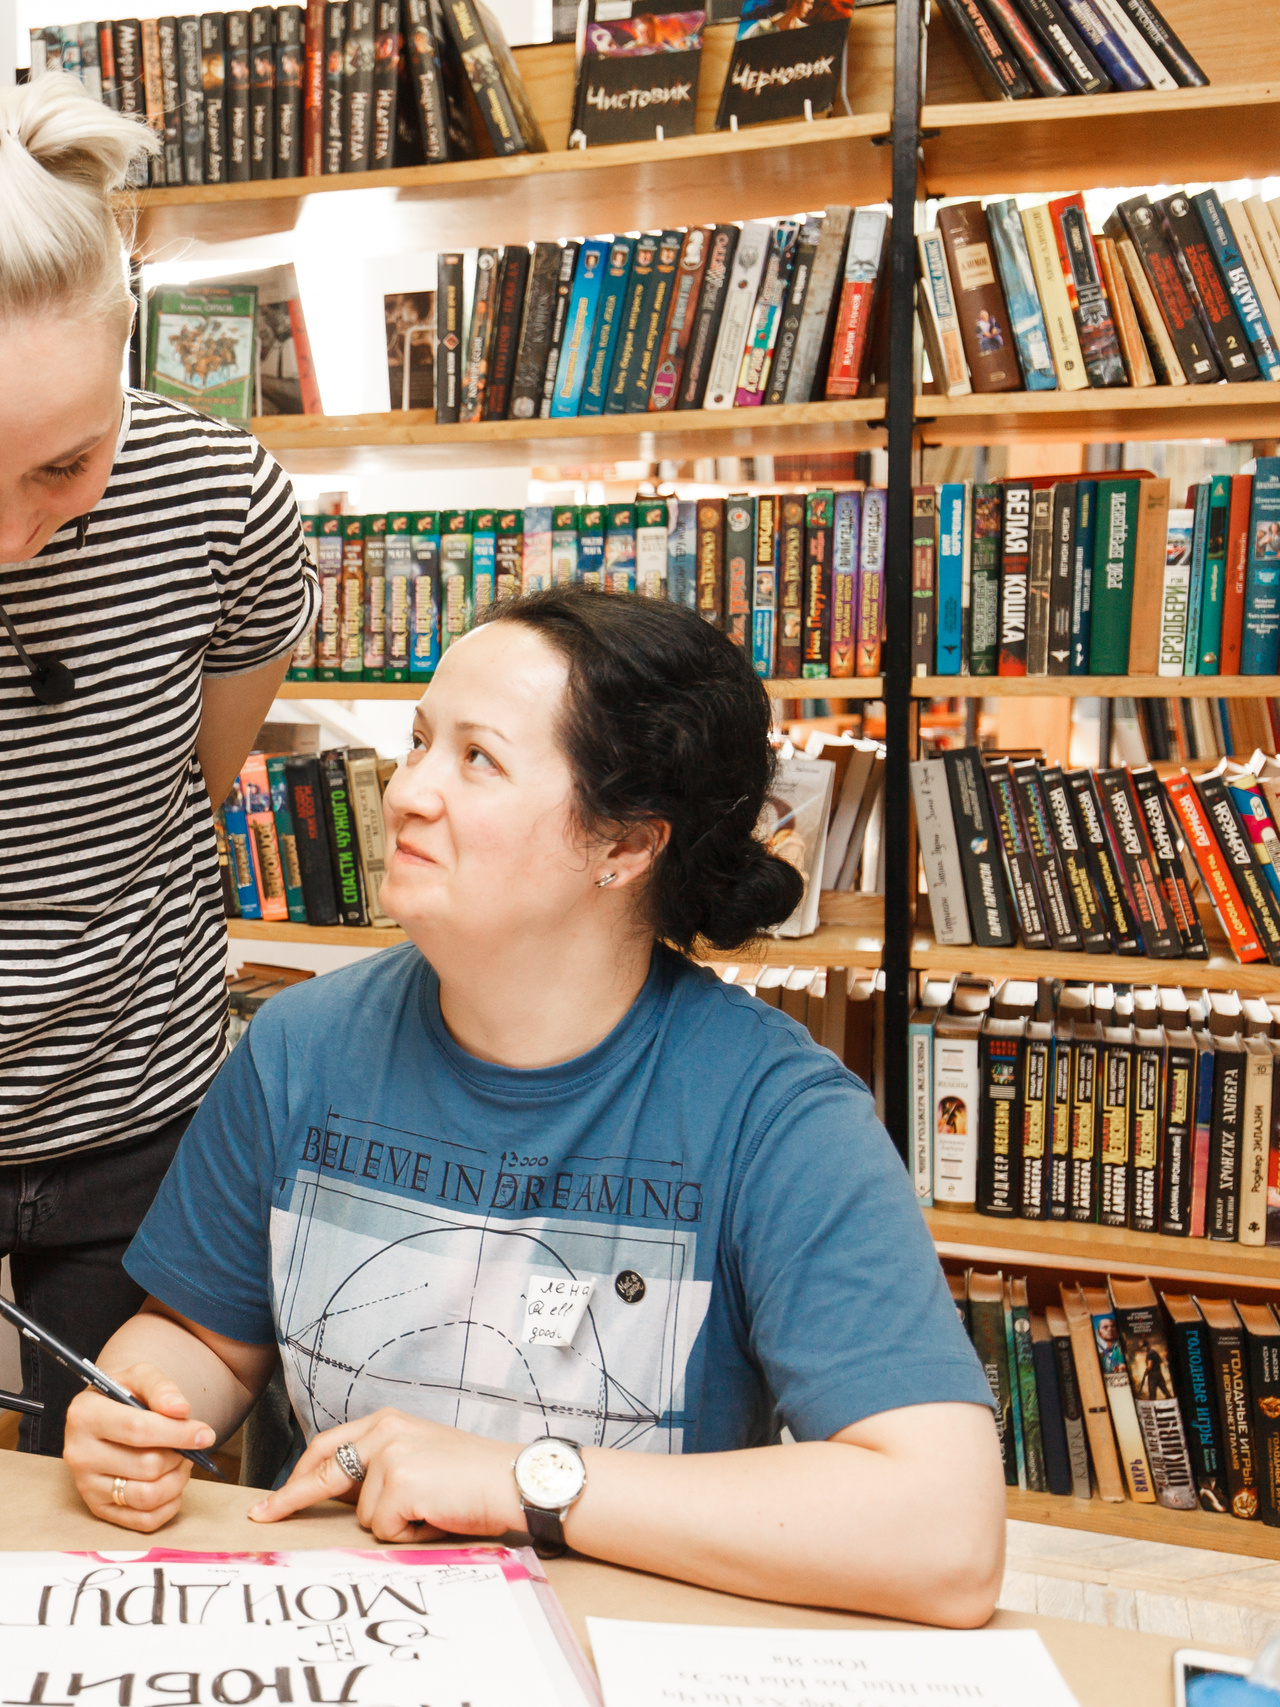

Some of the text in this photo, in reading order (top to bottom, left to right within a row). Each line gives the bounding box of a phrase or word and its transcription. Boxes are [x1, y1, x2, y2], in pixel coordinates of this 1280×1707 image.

[1228, 265, 1262, 322] МАЙЯ
[773, 332, 795, 392] INFERNO
[1226, 335, 1238, 349] 2
[838, 499, 854, 568] АРМАГЕДДОН
[867, 497, 881, 566] АРМАГЕДДОН
[1108, 492, 1128, 559] БРЭДБЕРИ
[1003, 489, 1029, 643] БЕЛАЯ КОШКА
[805, 564, 826, 660] Ник Перумов
[834, 574, 844, 641] НИК ПЕРУМОВ
[862, 571, 872, 640] НИК ПЕРУМОВ
[1161, 585, 1187, 665] БРЭДБЕРИ
[330, 790, 359, 904] СПАСТИ ЧУЖОГО
[1048, 786, 1078, 850] ГАРРИСОН
[1078, 790, 1104, 844] ГАРРИСОН
[1110, 790, 1142, 854] ГАРРИСОН
[1144, 795, 1175, 859] ГАРРИСОН
[1179, 794, 1211, 846] ГАРРИСОН
[1212, 800, 1252, 864] ГАРРИСОН
[1097, 850, 1128, 934] ВОЙНА РОБОТАМИ
[1211, 870, 1228, 893] 3000
[1243, 870, 1280, 942] ВЫБОР ТЬЮРИНГУ
[1225, 900, 1248, 937] ДОРОГА
[917, 1040, 926, 1174] МИРЫ РОДЖЕРА ЖЕЛЯЗНЫ
[1171, 1068, 1188, 1124] ЖЕЛЯЗНЫ
[992, 1099, 1010, 1207] РОДЖЕР ЖЕЛЯЗНЫ
[1023, 1100, 1044, 1158] ЖЕЛЯЗНЫ
[1052, 1102, 1068, 1155] ЖЕЛЯЗНЫ
[1072, 1103, 1092, 1160] ЖЕЛЯЗНЫ
[1101, 1104, 1128, 1165] ЖЕЛЯЗНЫ
[1134, 1110, 1157, 1168] ЖЕЛЯЗНЫ
[1219, 1068, 1239, 1191] ХРОНИКИ АМБЕРА
[1251, 1105, 1263, 1193] Роджер ЗИЛАЗНИ
[437, 1159, 486, 1207] IN
[489, 1171, 704, 1223] DREAMING
[1023, 1159, 1032, 1205] ХРОНИКИ
[1030, 1159, 1043, 1207] АМБЕРА
[1058, 1160, 1067, 1202] АМБЕРА
[1072, 1160, 1080, 1207] ХРОНИКИ
[1080, 1161, 1091, 1209] АМБЕРА
[1103, 1165, 1112, 1213] ХРОНИКИ
[1112, 1166, 1126, 1214] АМБЕРА
[1135, 1168, 1143, 1217] ХРОНИКИ
[1143, 1170, 1154, 1218] АМБЕРА
[1170, 1135, 1182, 1222] ДОЛИНА ПРОКЛЯТИЙ
[1186, 1330, 1213, 1445] голодные игры
[1262, 1346, 1271, 1383] КОЛЛИНЗ
[1271, 1347, 1279, 1381] СЬЮЗЕН
[1222, 1374, 1235, 1431] ВСПЫХНЕТ
[1229, 1433, 1239, 1470] ПЛАМЯ
[1230, 1349, 1253, 1486] ГОЛОДНЫЕ ИГРЫ:
[1130, 1459, 1149, 1493] ВИХРЬ
[238, 1580, 430, 1628] МОЙ
